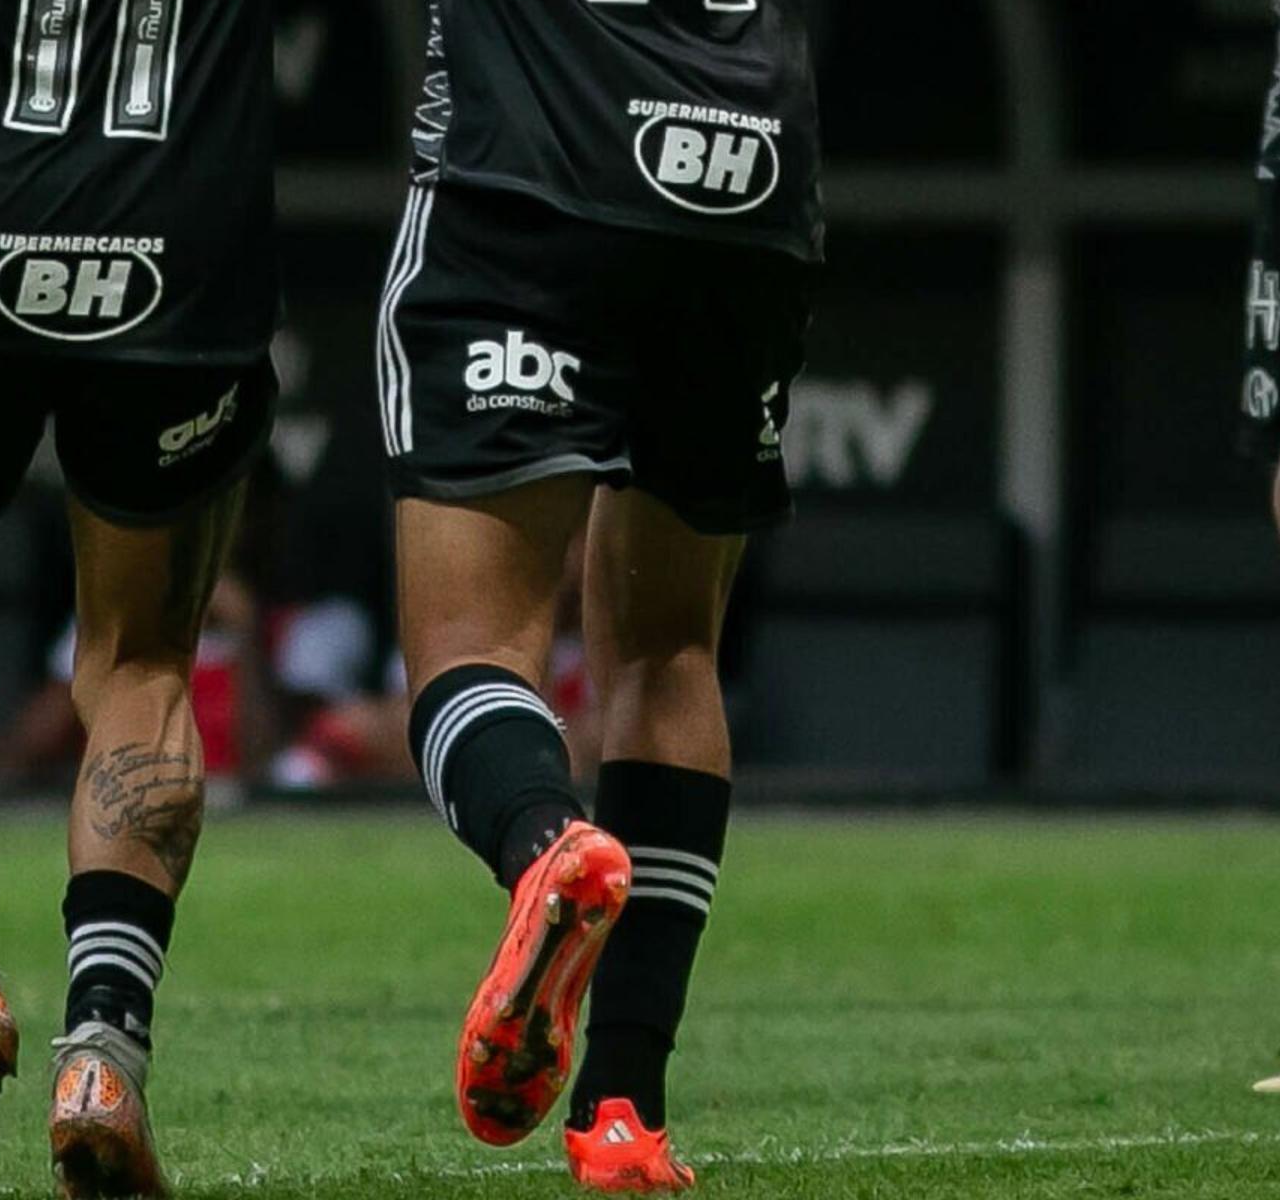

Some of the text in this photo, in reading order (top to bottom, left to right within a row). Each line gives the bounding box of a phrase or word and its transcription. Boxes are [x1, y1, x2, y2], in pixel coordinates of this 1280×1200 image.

[626, 99, 781, 136] SUPERMERCADOS
[657, 126, 760, 195] BH
[15, 259, 133, 318] BH
[465, 329, 581, 402] abc
[466, 394, 487, 413] da
